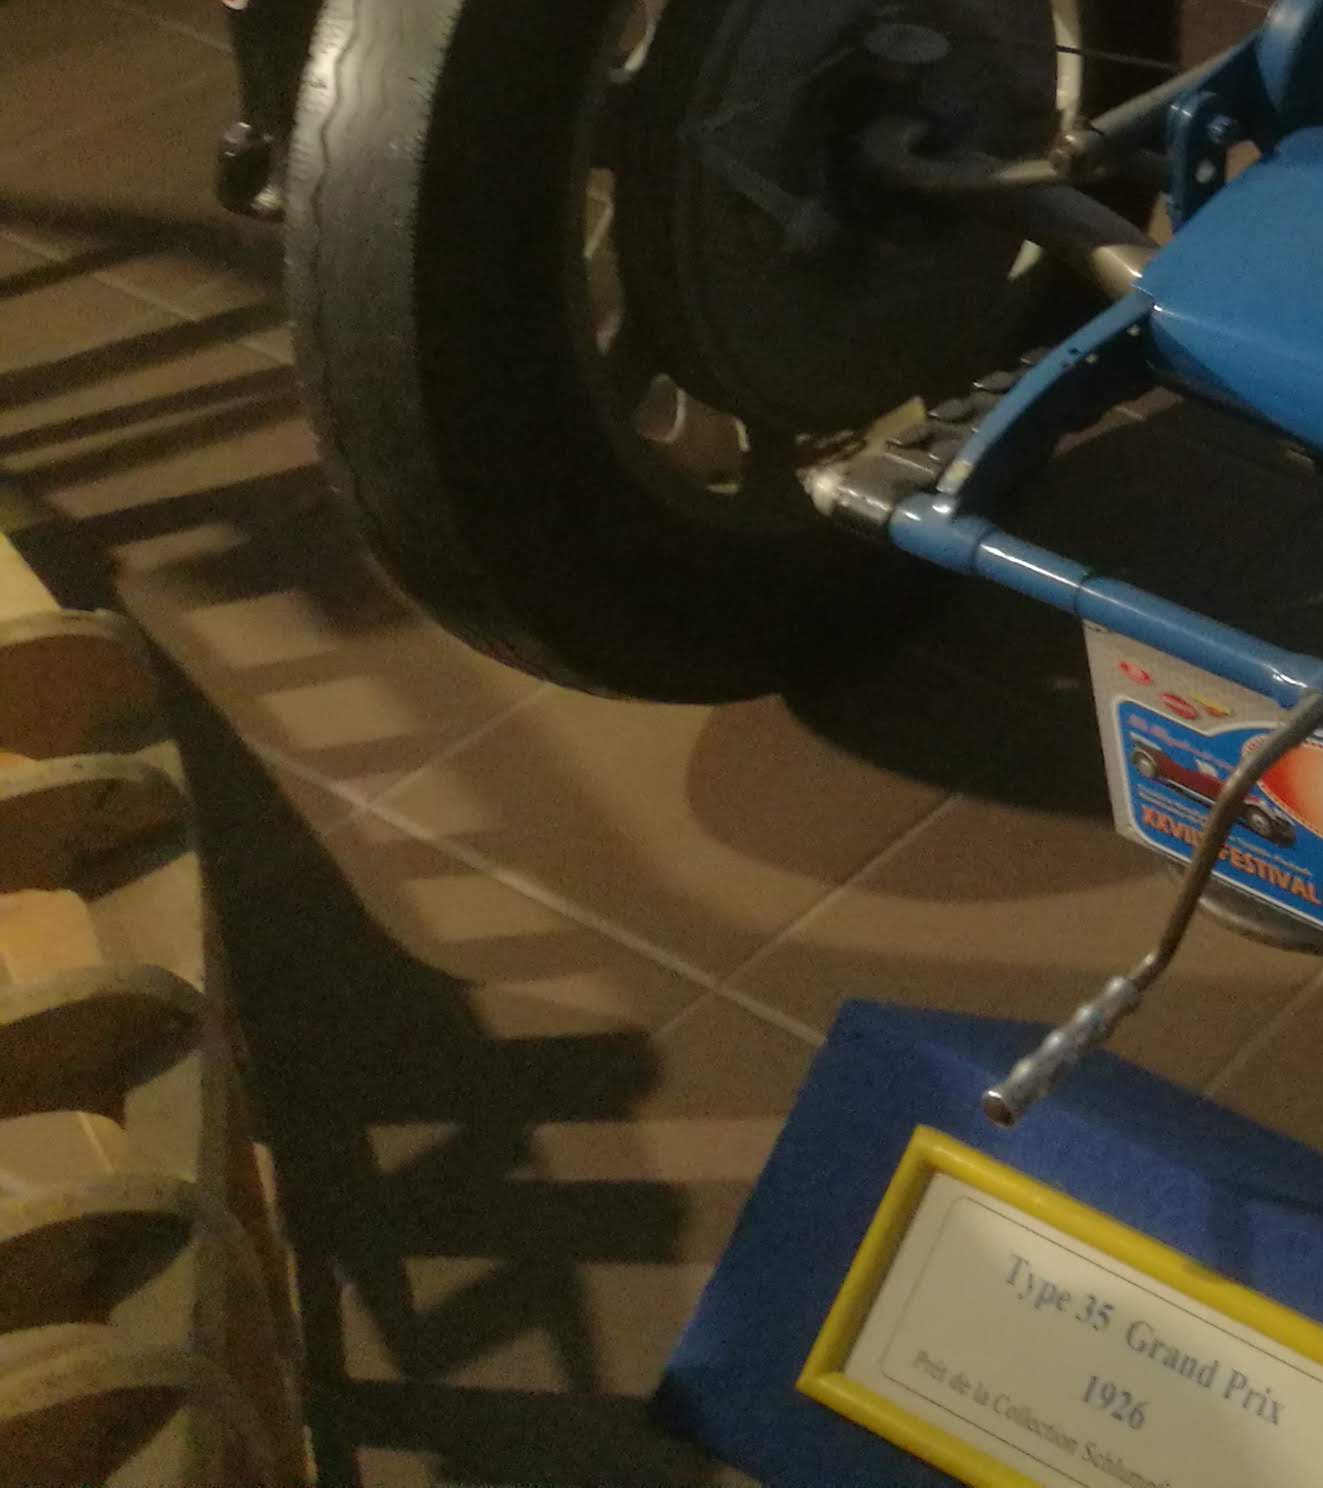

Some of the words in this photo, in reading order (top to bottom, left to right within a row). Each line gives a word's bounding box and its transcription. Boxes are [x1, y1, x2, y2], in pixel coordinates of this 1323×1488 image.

[1218, 845, 1322, 906] ESTIVAL
[1004, 1253, 1071, 1311] Type
[1075, 1293, 1115, 1331] 35
[1126, 1319, 1219, 1389] Grand
[1223, 1367, 1285, 1425] Prix
[949, 1371, 972, 1396] de
[973, 1381, 991, 1407] la
[993, 1393, 1080, 1456] Collection
[1081, 1374, 1151, 1430] 1926
